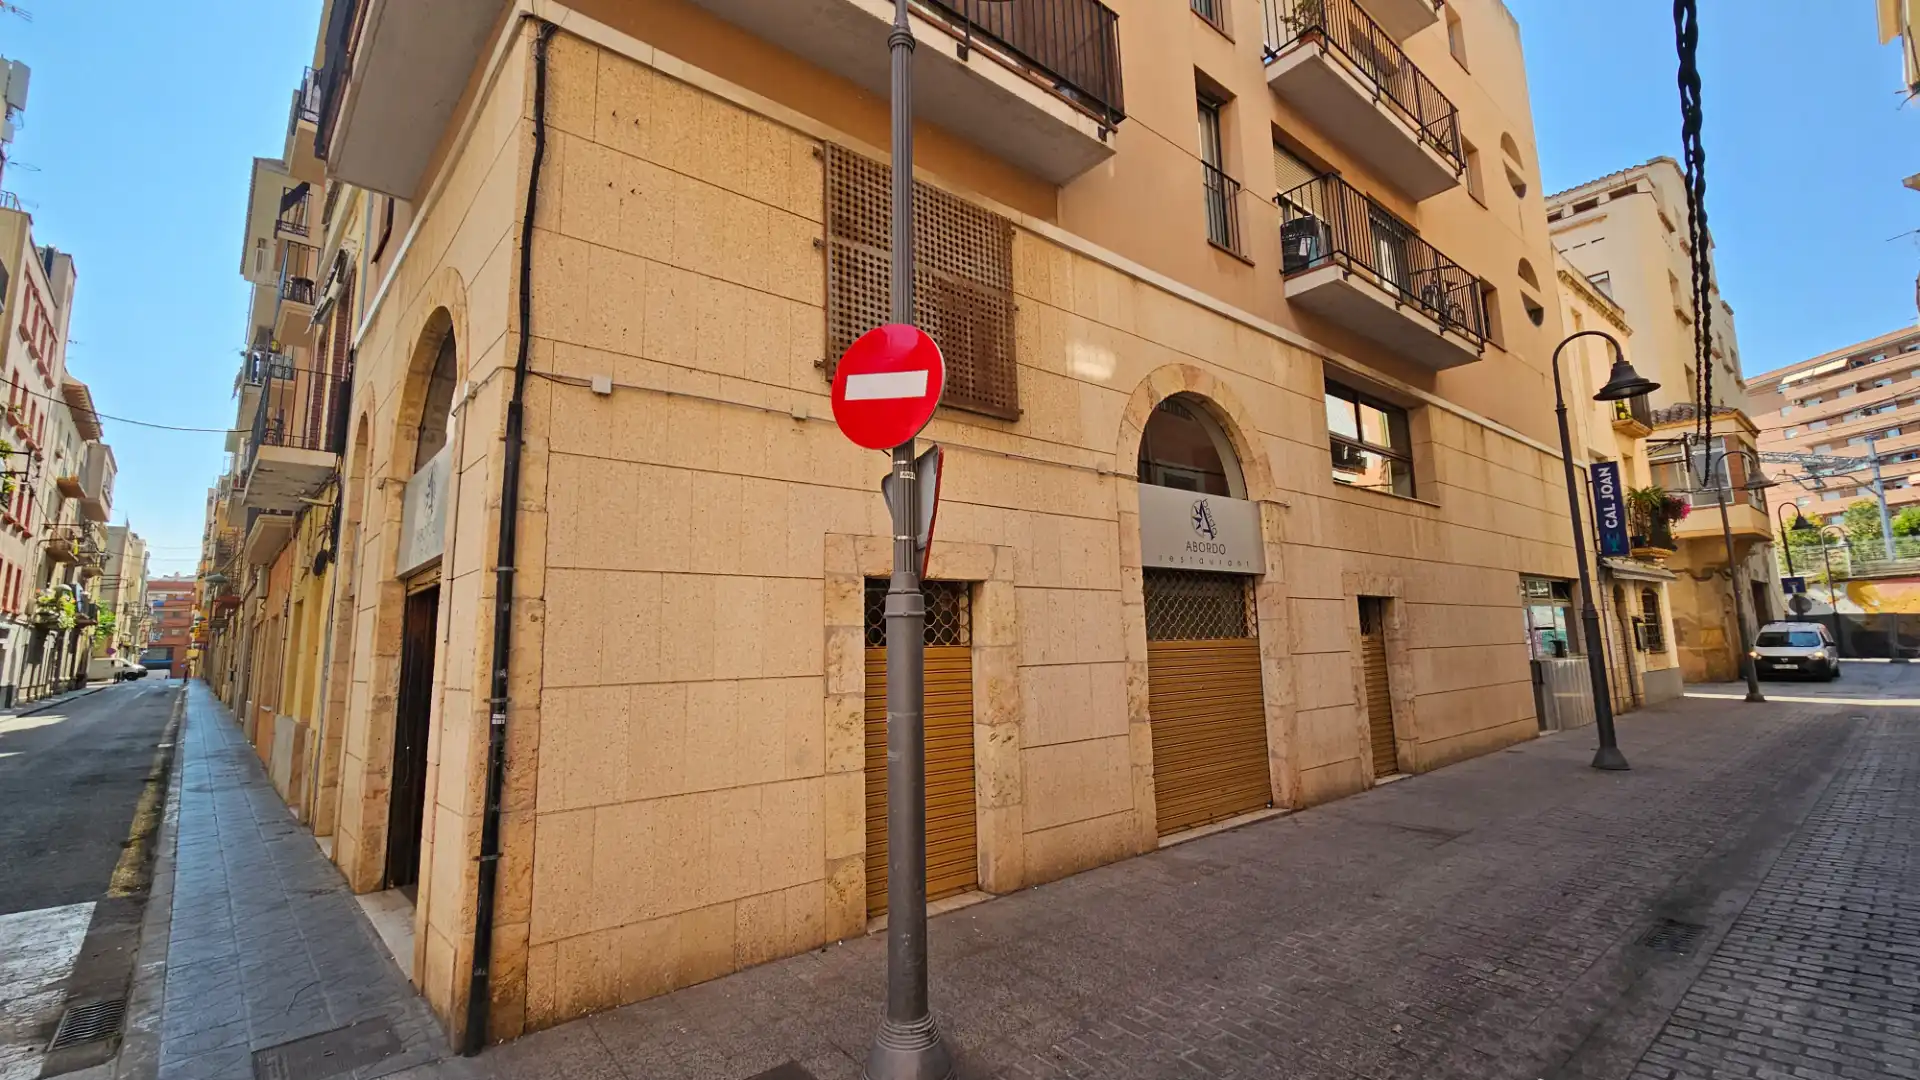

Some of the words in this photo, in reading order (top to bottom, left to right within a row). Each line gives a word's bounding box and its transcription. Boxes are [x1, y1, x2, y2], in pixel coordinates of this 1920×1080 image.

[1598, 467, 1615, 501] JOAN
[1603, 502, 1618, 529] CAL
[1185, 540, 1227, 555] ABORDO
[1158, 554, 1250, 568] restaurant
